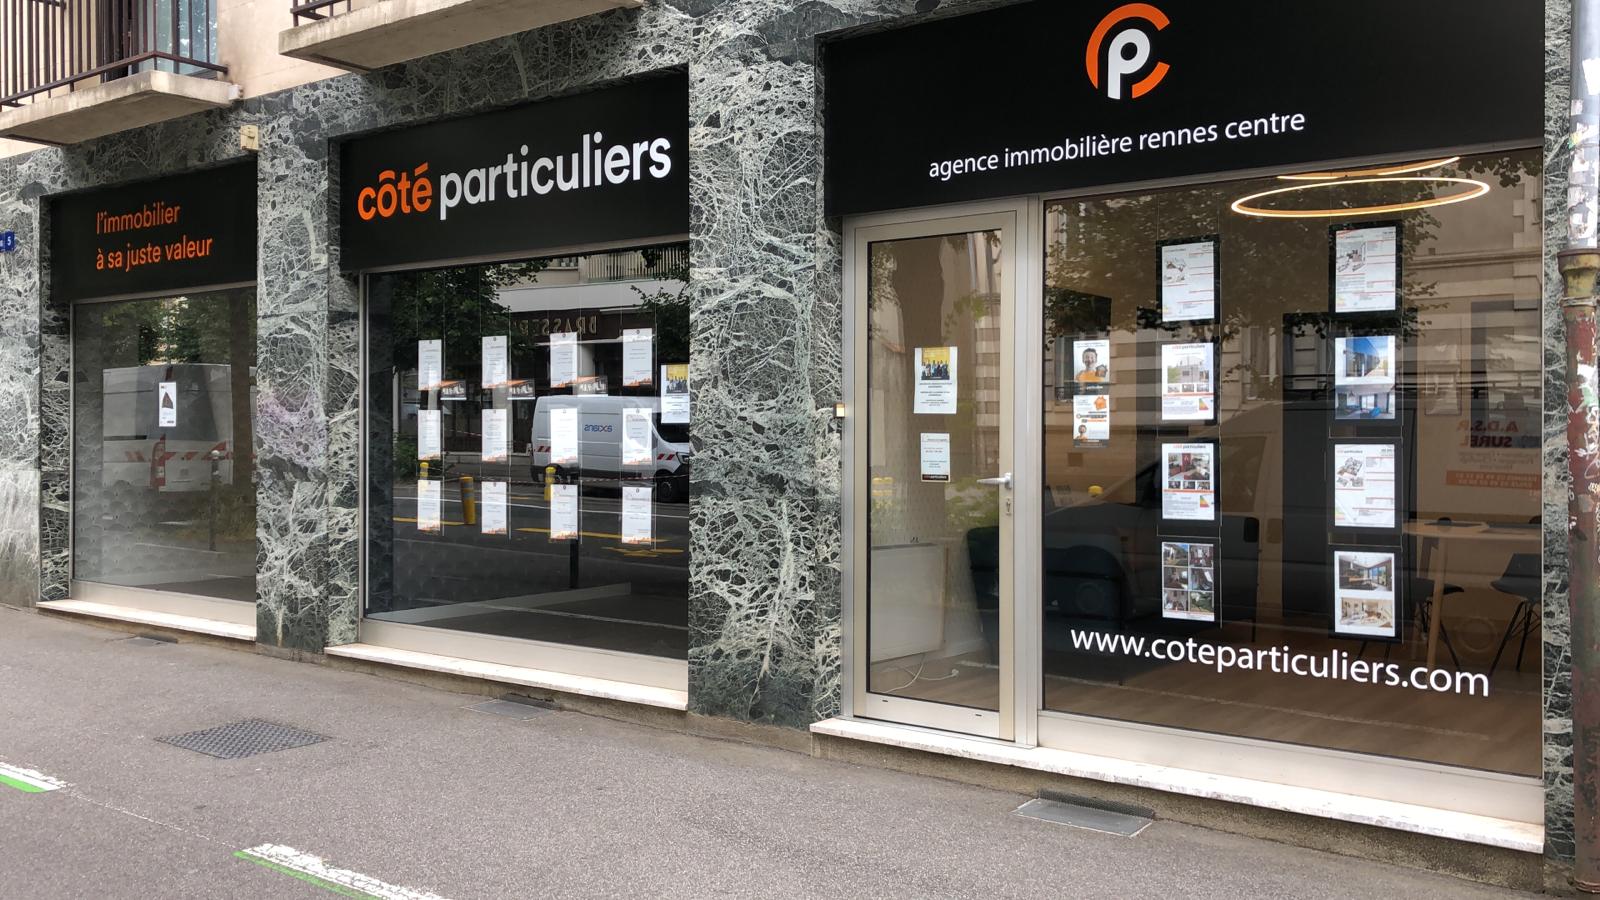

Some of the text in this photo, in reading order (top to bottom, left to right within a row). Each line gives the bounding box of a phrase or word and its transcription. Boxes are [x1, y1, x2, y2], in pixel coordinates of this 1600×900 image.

[357, 131, 672, 221] côté particuliers
[929, 112, 1306, 181] agence immobilière rennes centre
[96, 202, 181, 234] l'immobilier
[96, 236, 213, 272] à sa juste valeur
[1070, 629, 1490, 698] www.coteparticuliers.com
